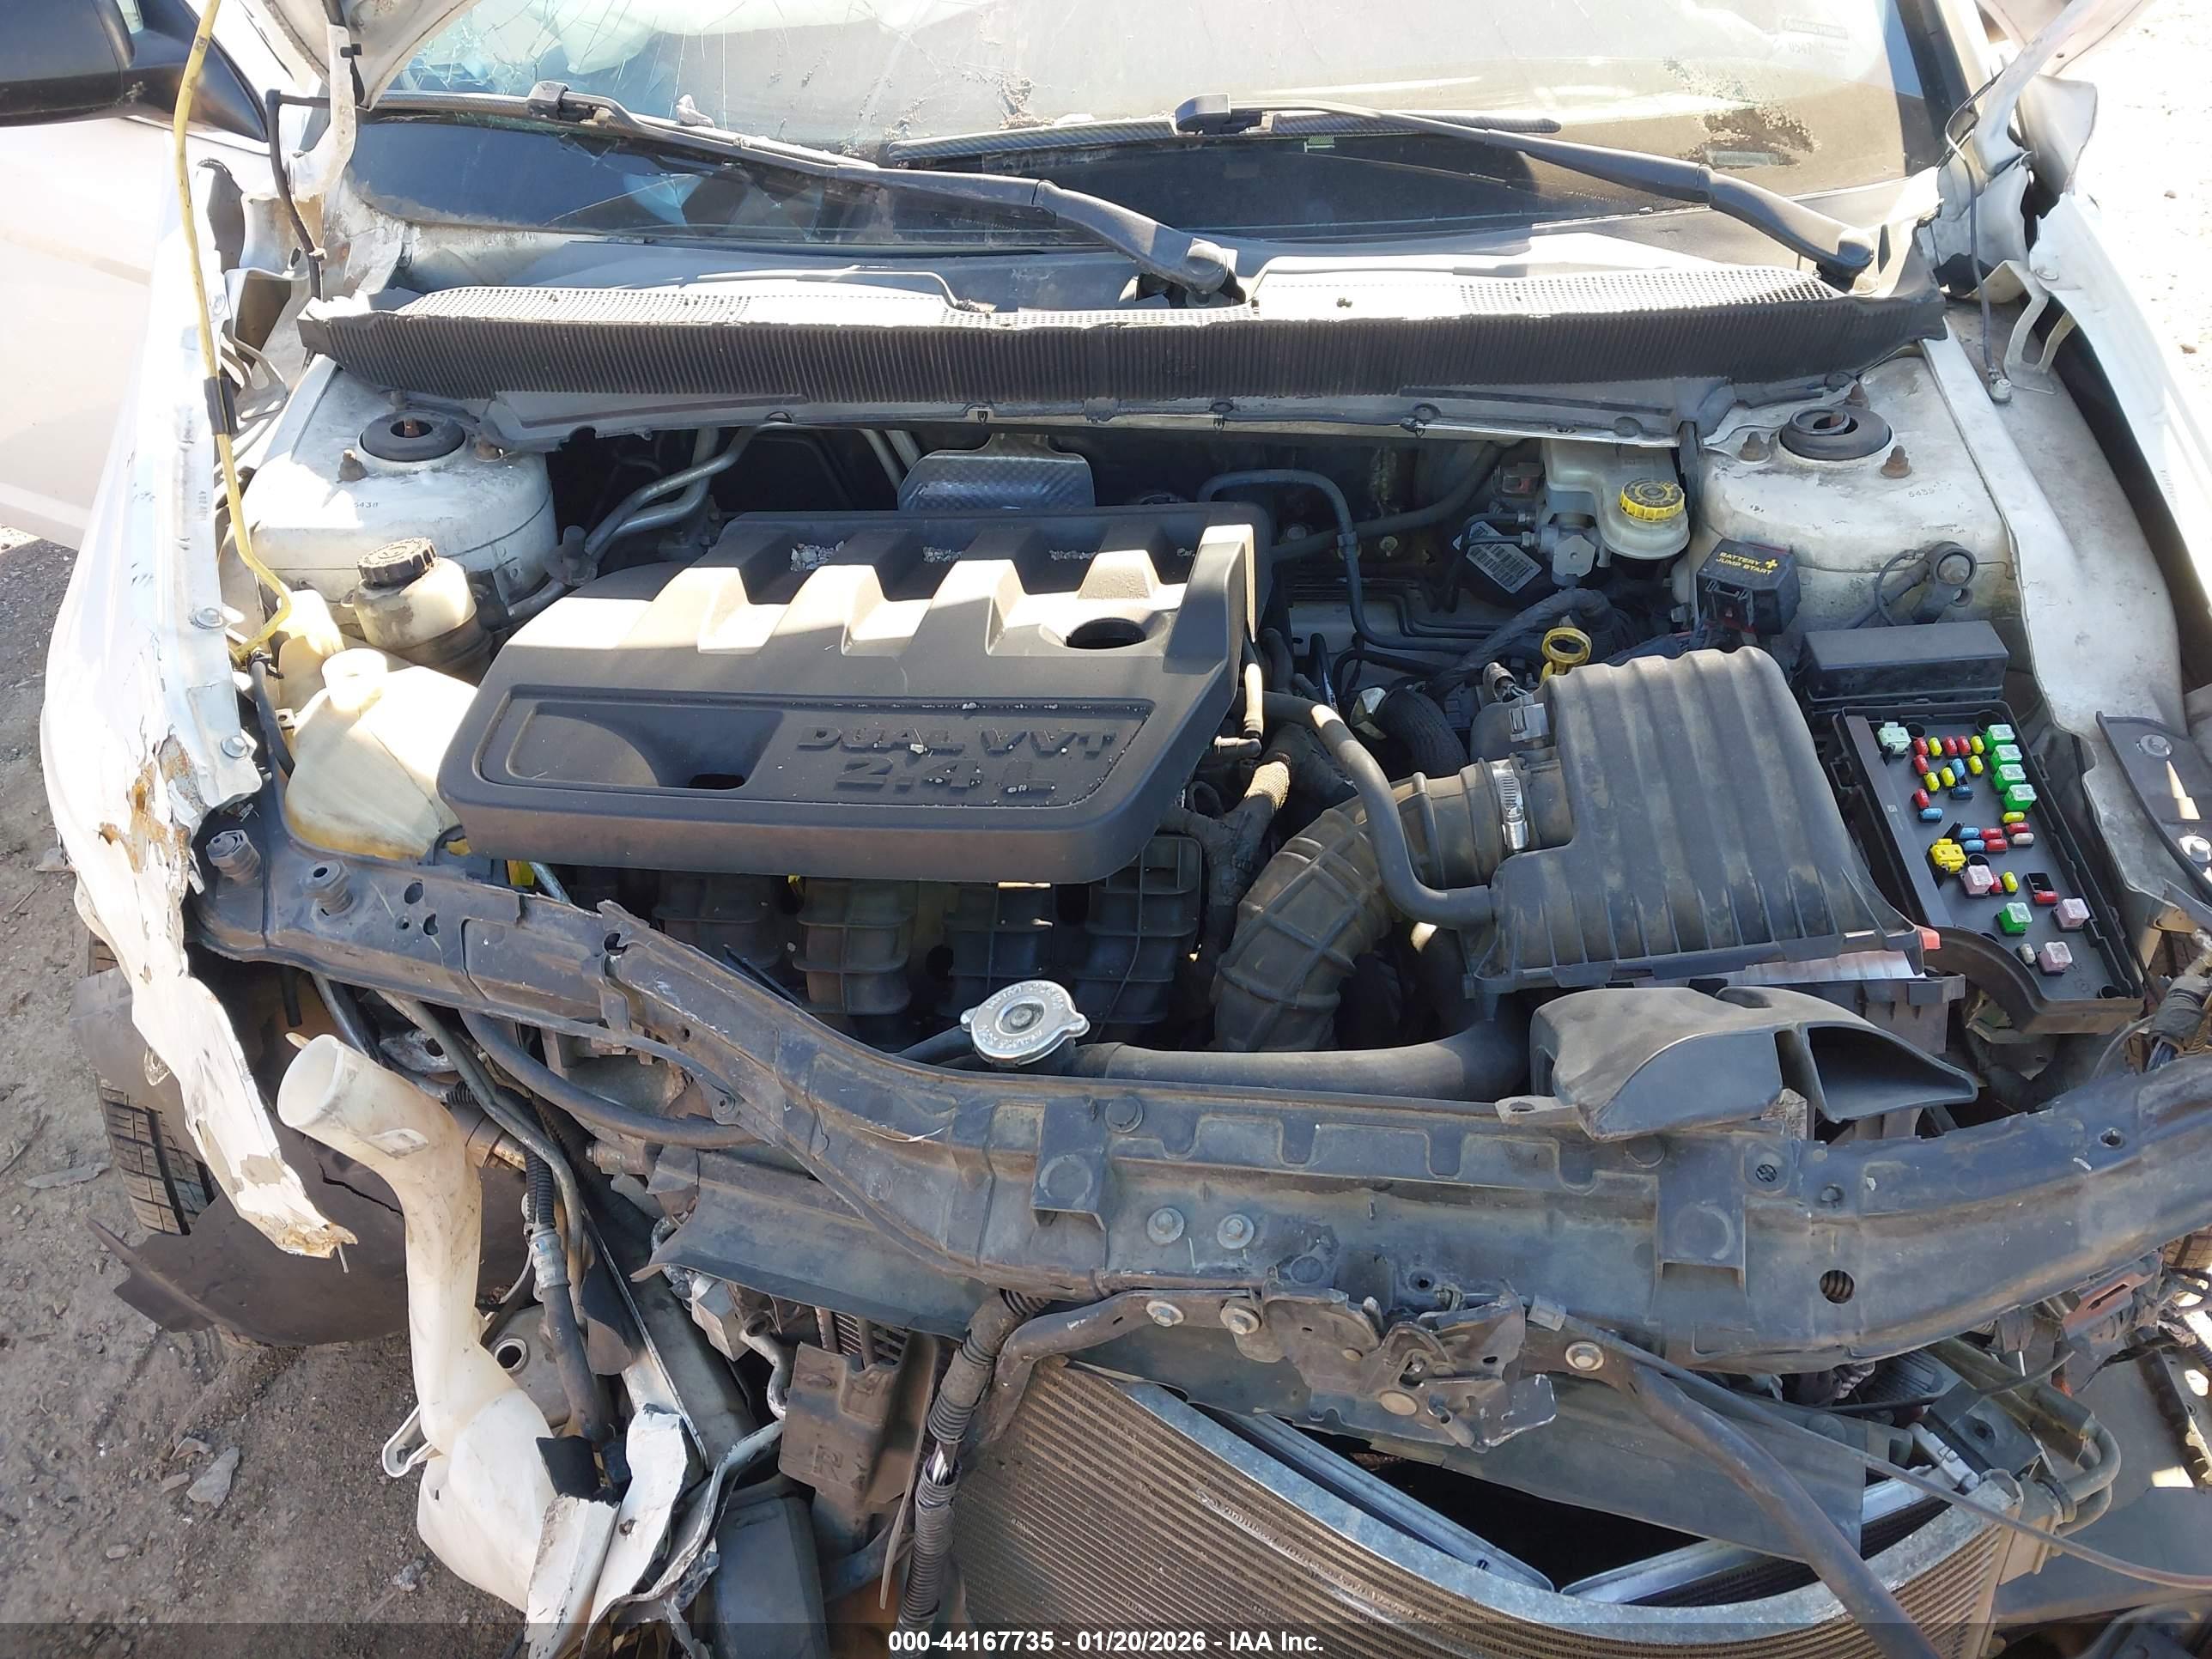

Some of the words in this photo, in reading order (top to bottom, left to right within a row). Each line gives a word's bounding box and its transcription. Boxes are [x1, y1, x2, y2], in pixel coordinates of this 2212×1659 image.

[1716, 557, 1741, 568] JUMP
[1742, 563, 1773, 576] START
[1719, 551, 1762, 566] BATTERY
[796, 726, 965, 757] DUAL
[981, 728, 1117, 758] VVT
